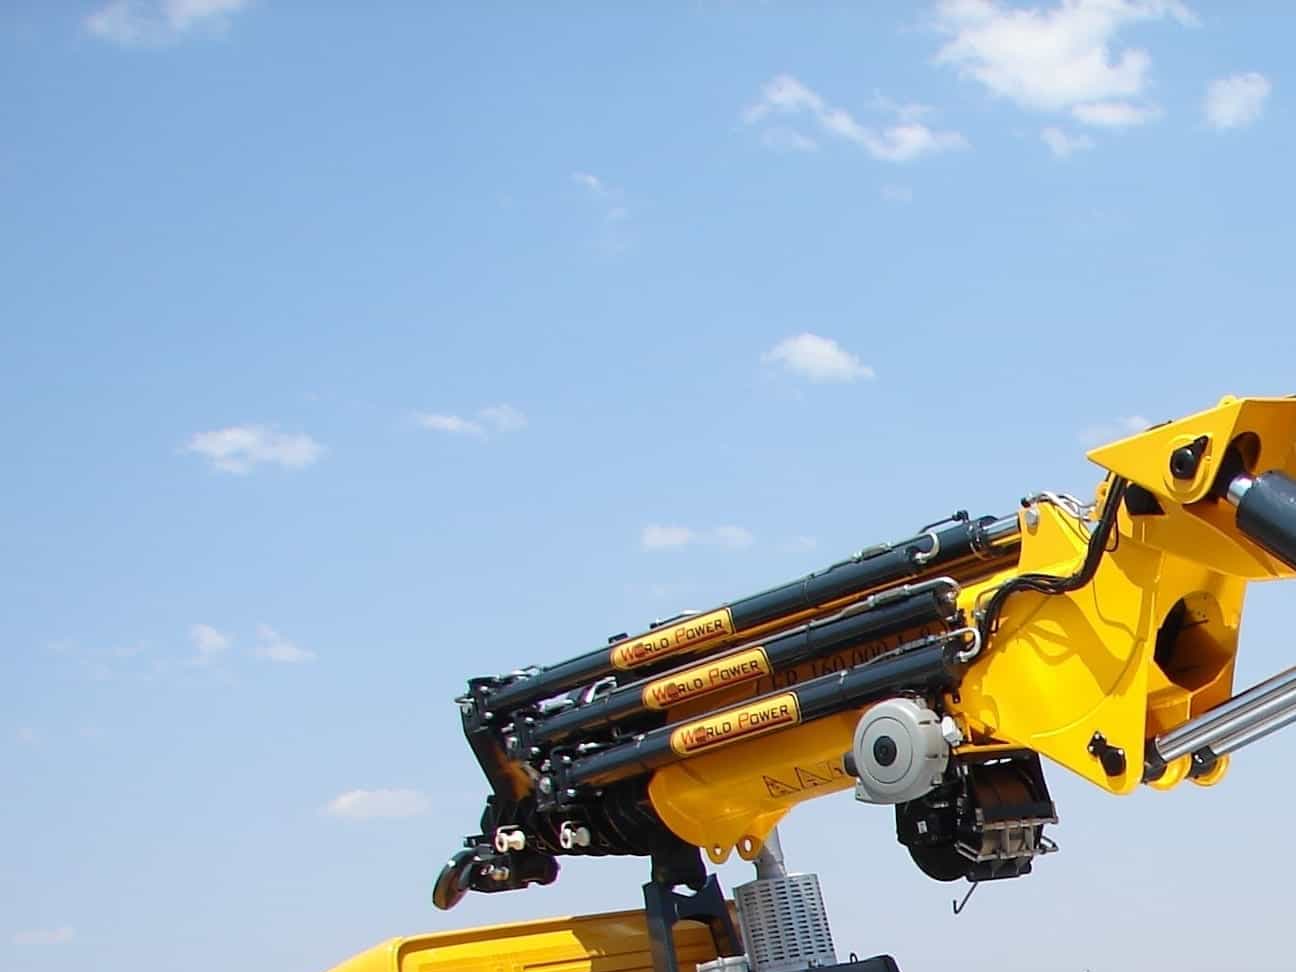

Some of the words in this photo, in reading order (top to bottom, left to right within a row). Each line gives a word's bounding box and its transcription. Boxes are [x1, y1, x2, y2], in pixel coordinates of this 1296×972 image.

[621, 637, 669, 662] WORLD
[675, 619, 722, 644] POWER
[652, 677, 703, 702] WORLD
[708, 659, 759, 686] POWER
[681, 721, 731, 745] WORLD
[738, 704, 788, 730] POWER
